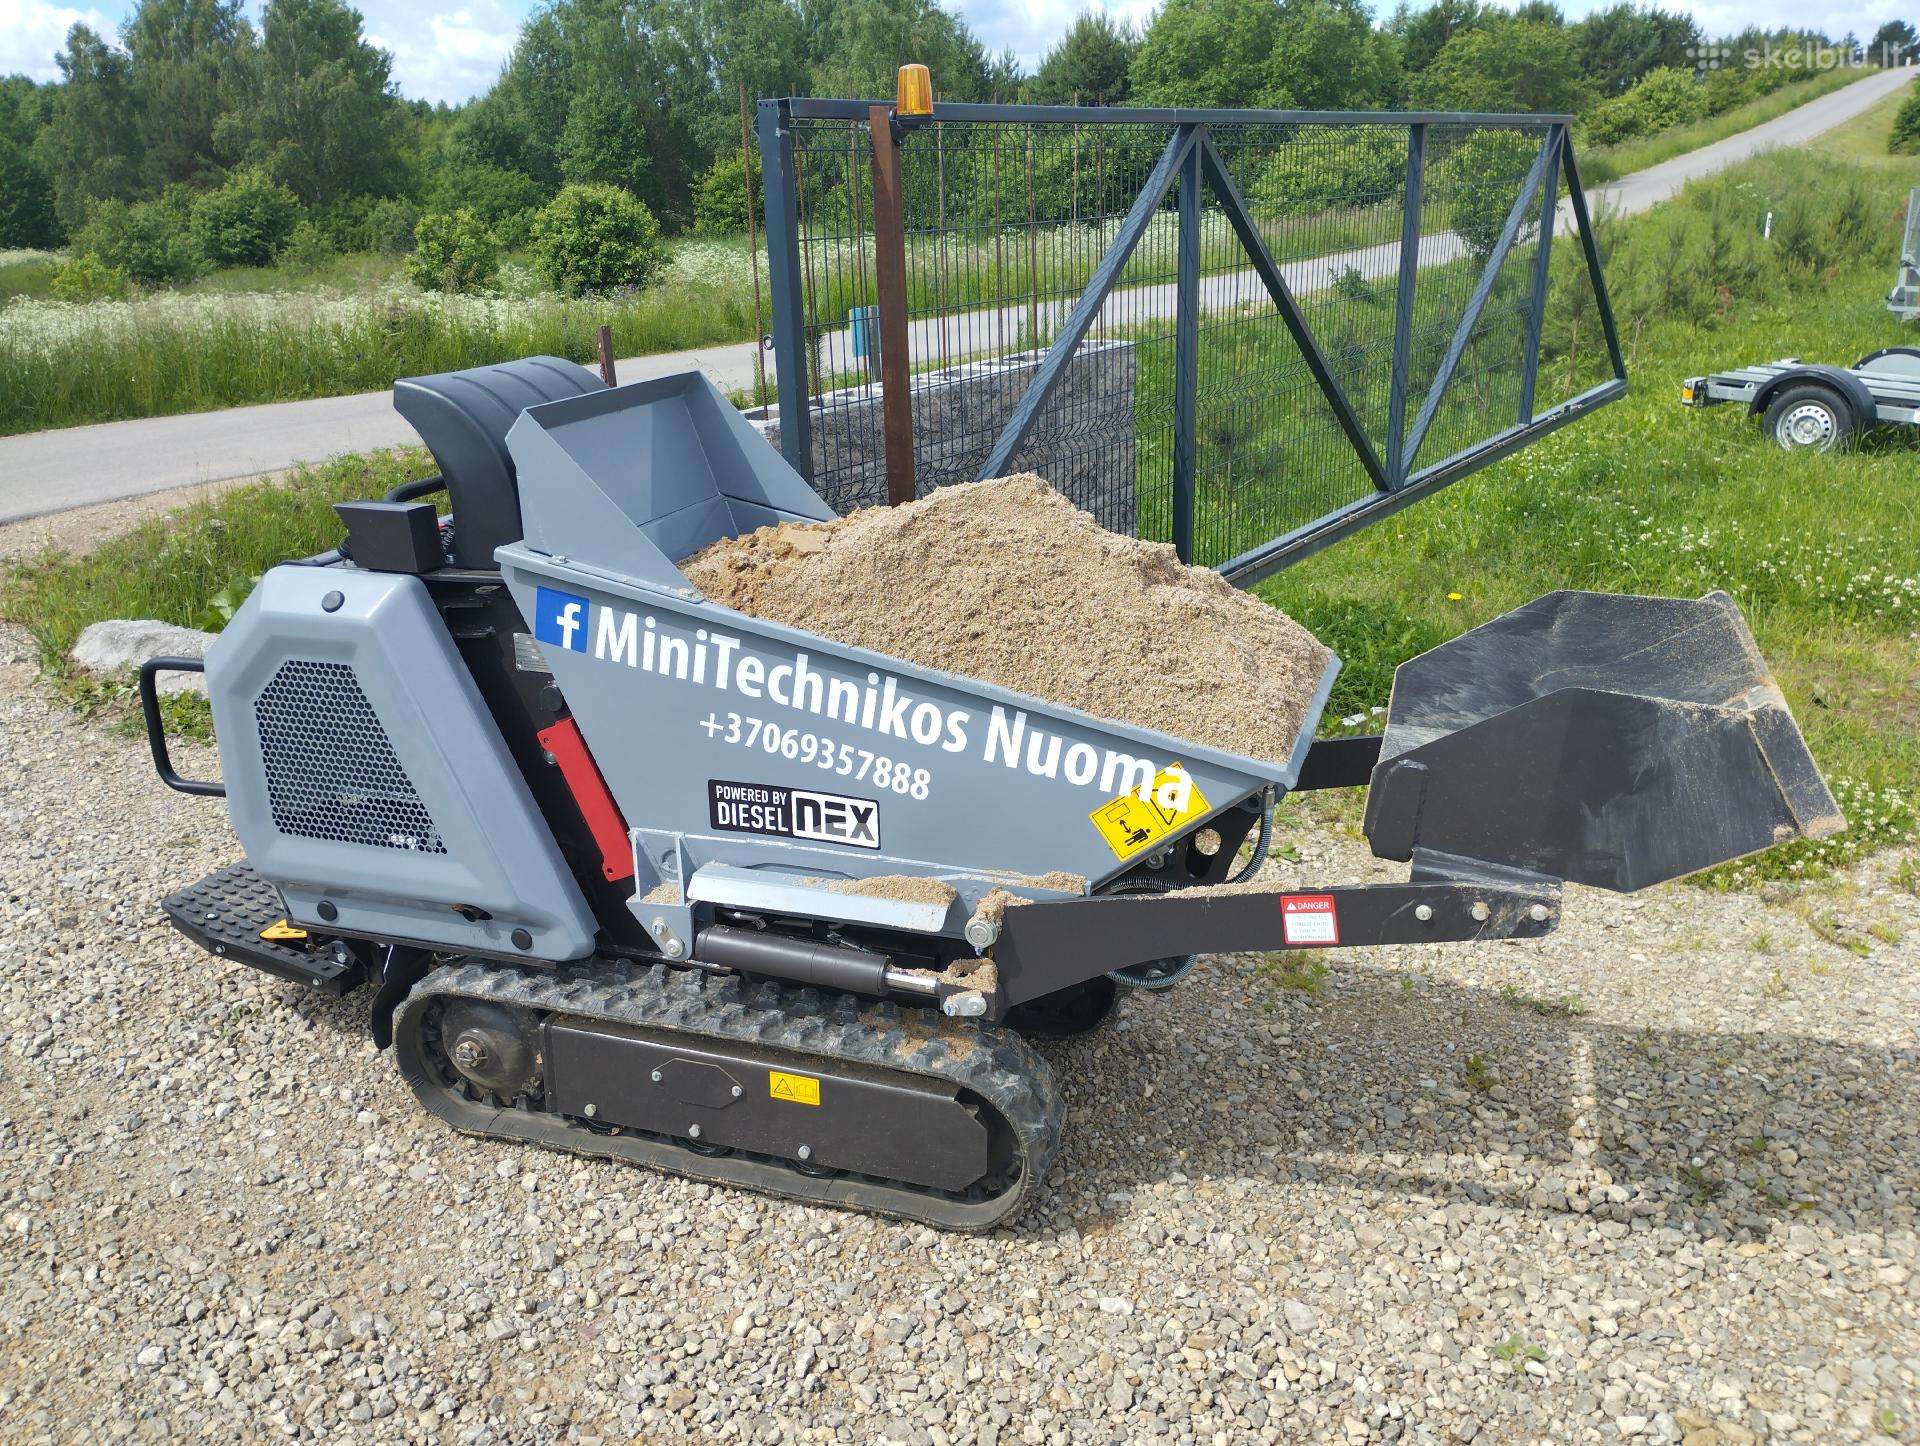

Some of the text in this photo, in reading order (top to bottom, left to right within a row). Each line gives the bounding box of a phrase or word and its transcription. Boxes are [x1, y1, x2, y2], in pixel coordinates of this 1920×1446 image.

[595, 605, 1193, 813] MiniTechnikos Nuoma
[699, 712, 931, 800] +37069357888
[715, 785, 787, 806] POWERED BY
[717, 802, 789, 832] DIESEL
[1297, 901, 1330, 910] DANGER
